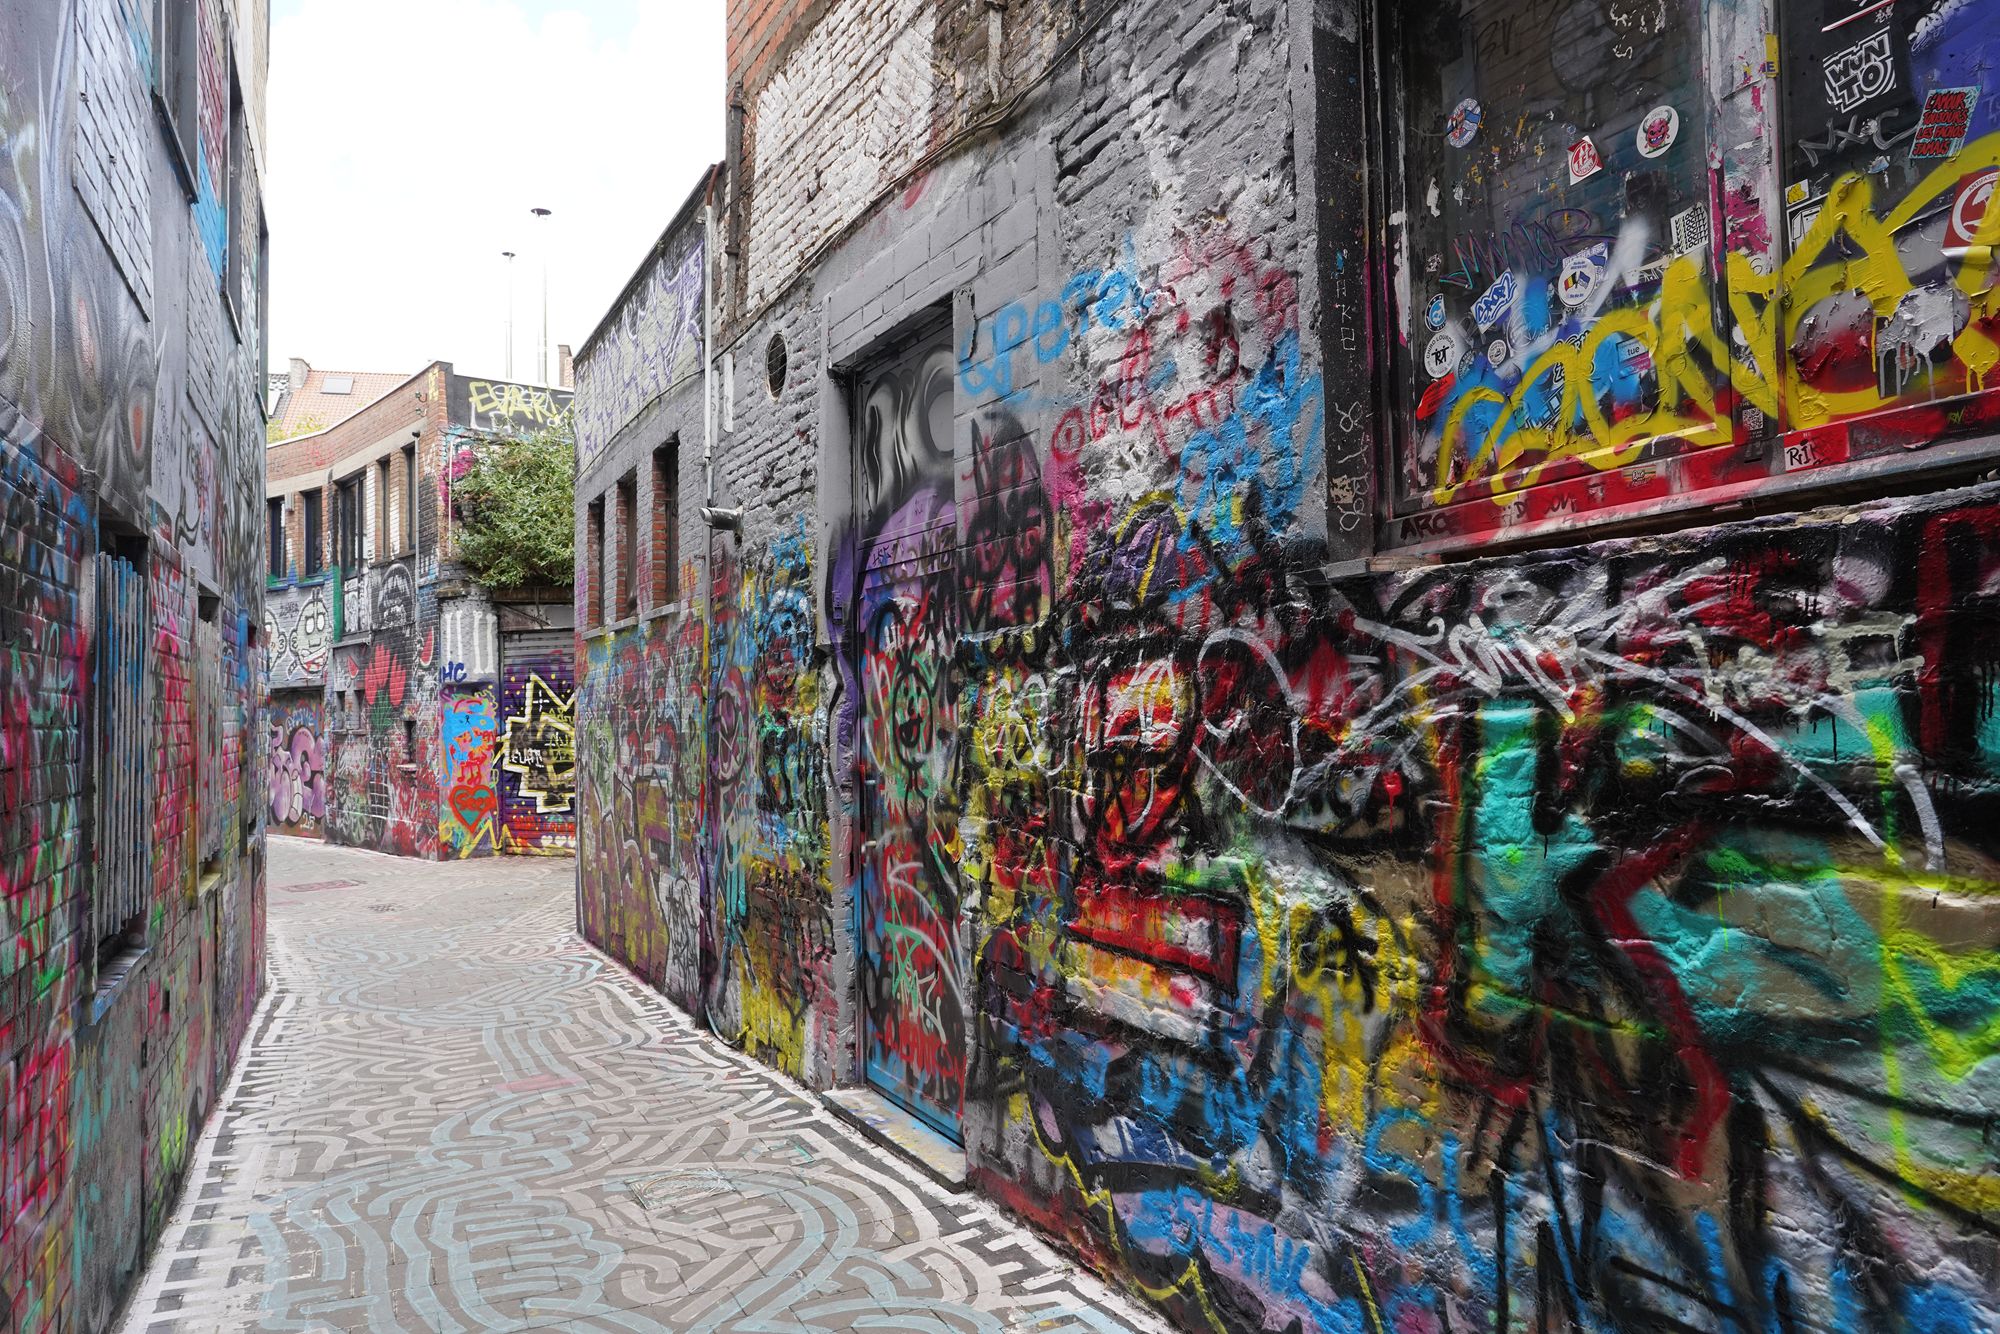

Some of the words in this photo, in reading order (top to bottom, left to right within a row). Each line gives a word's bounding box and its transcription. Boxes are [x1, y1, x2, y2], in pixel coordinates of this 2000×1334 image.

[1923, 109, 1968, 125] TOUJOURS
[1916, 126, 1934, 139] LES
[1934, 124, 1966, 139] FACHOS
[1912, 140, 1951, 155] JAMAIS
